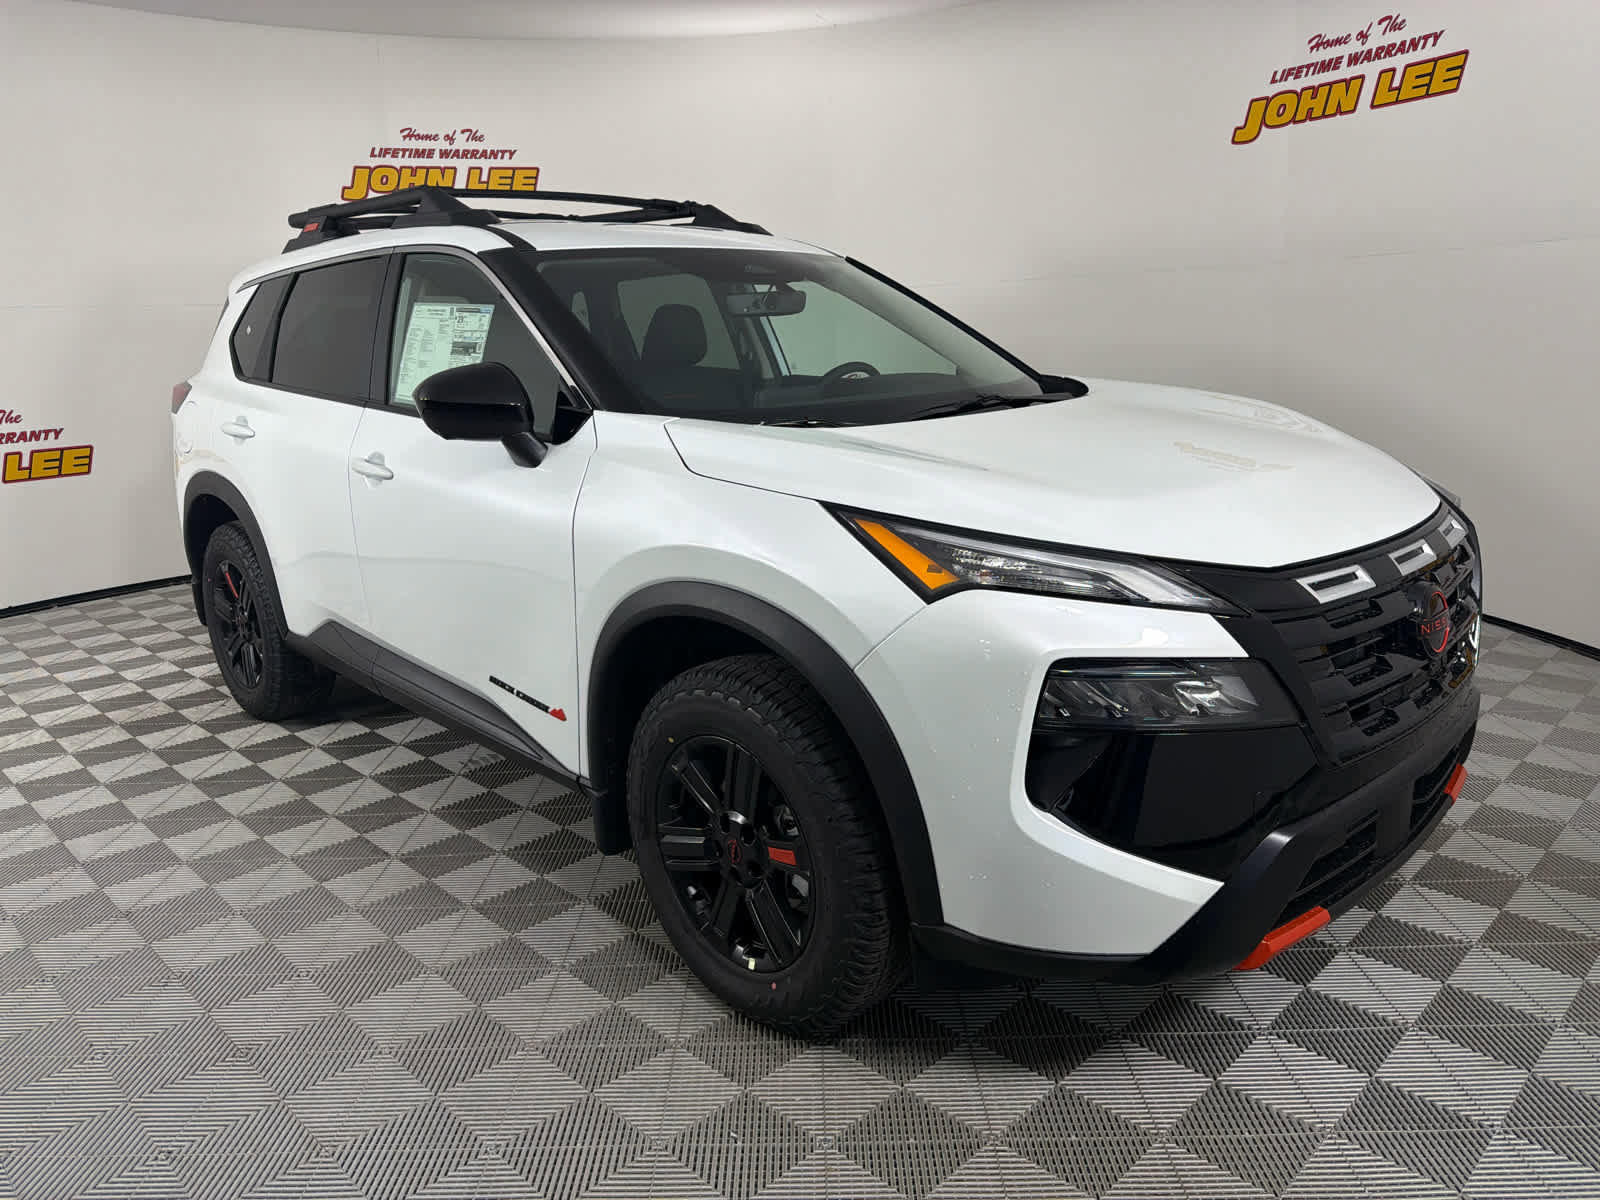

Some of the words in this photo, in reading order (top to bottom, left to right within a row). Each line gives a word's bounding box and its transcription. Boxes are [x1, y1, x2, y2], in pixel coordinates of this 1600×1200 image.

[1307, 33, 1352, 53] Home
[1355, 22, 1373, 45] of
[1377, 13, 1407, 36] The
[1270, 56, 1344, 84] LIFETIME
[1347, 30, 1445, 67] WARRANTY
[1231, 74, 1365, 144] JOHN
[1369, 48, 1470, 110] LEE
[370, 147, 435, 159] LIFETIME
[438, 149, 518, 160] WARRANTY
[400, 127, 440, 142] Home
[443, 129, 456, 145] of
[461, 128, 485, 143] The
[341, 165, 457, 201] JOHN
[465, 167, 540, 192] LEE
[2, 444, 93, 484] LEE
[1420, 616, 1448, 634] NISS
